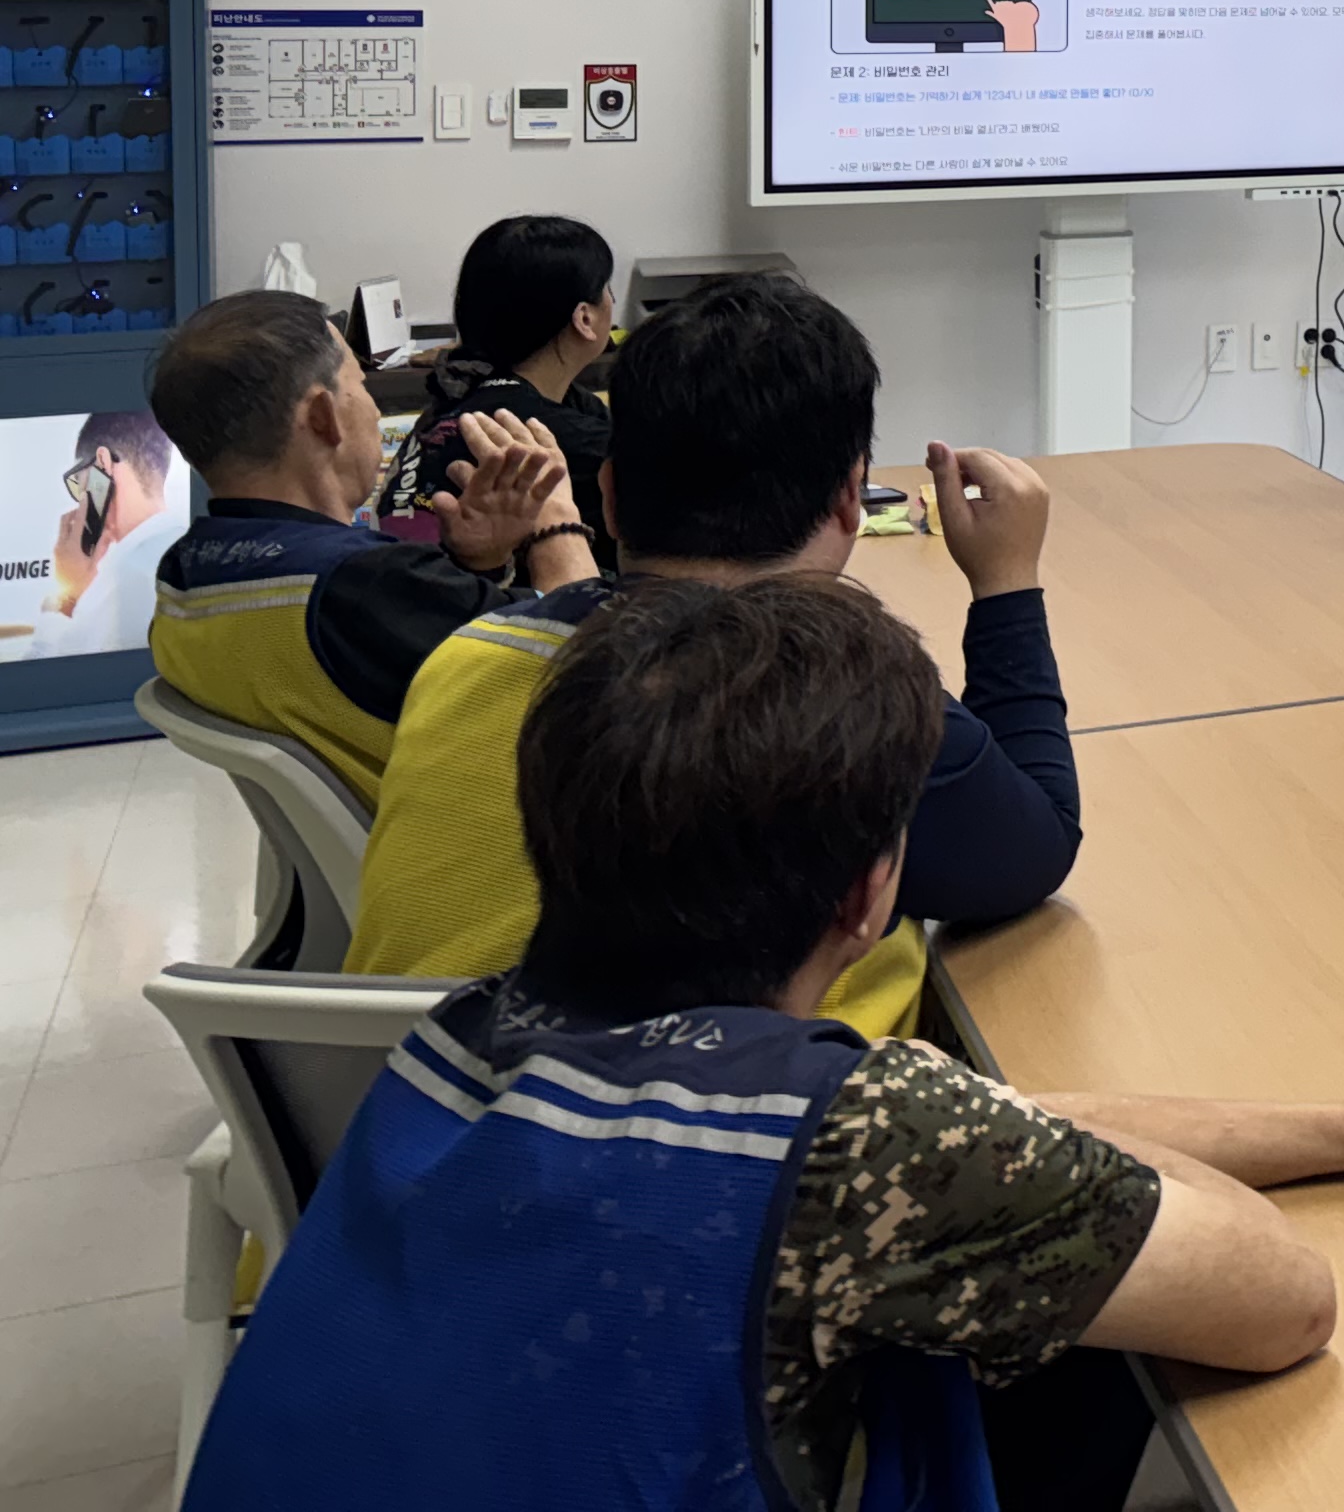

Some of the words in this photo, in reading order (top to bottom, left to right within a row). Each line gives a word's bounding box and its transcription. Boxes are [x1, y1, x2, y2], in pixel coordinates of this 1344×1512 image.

[213, 13, 264, 24] 피난안내도
[830, 66, 855, 78] 문제
[874, 66, 922, 78] 비밀번호
[925, 65, 949, 77] 관리
[864, 92, 916, 103] 비밀번호는
[919, 91, 959, 102] 기억하기
[864, 127, 915, 137] 비밀번호는
